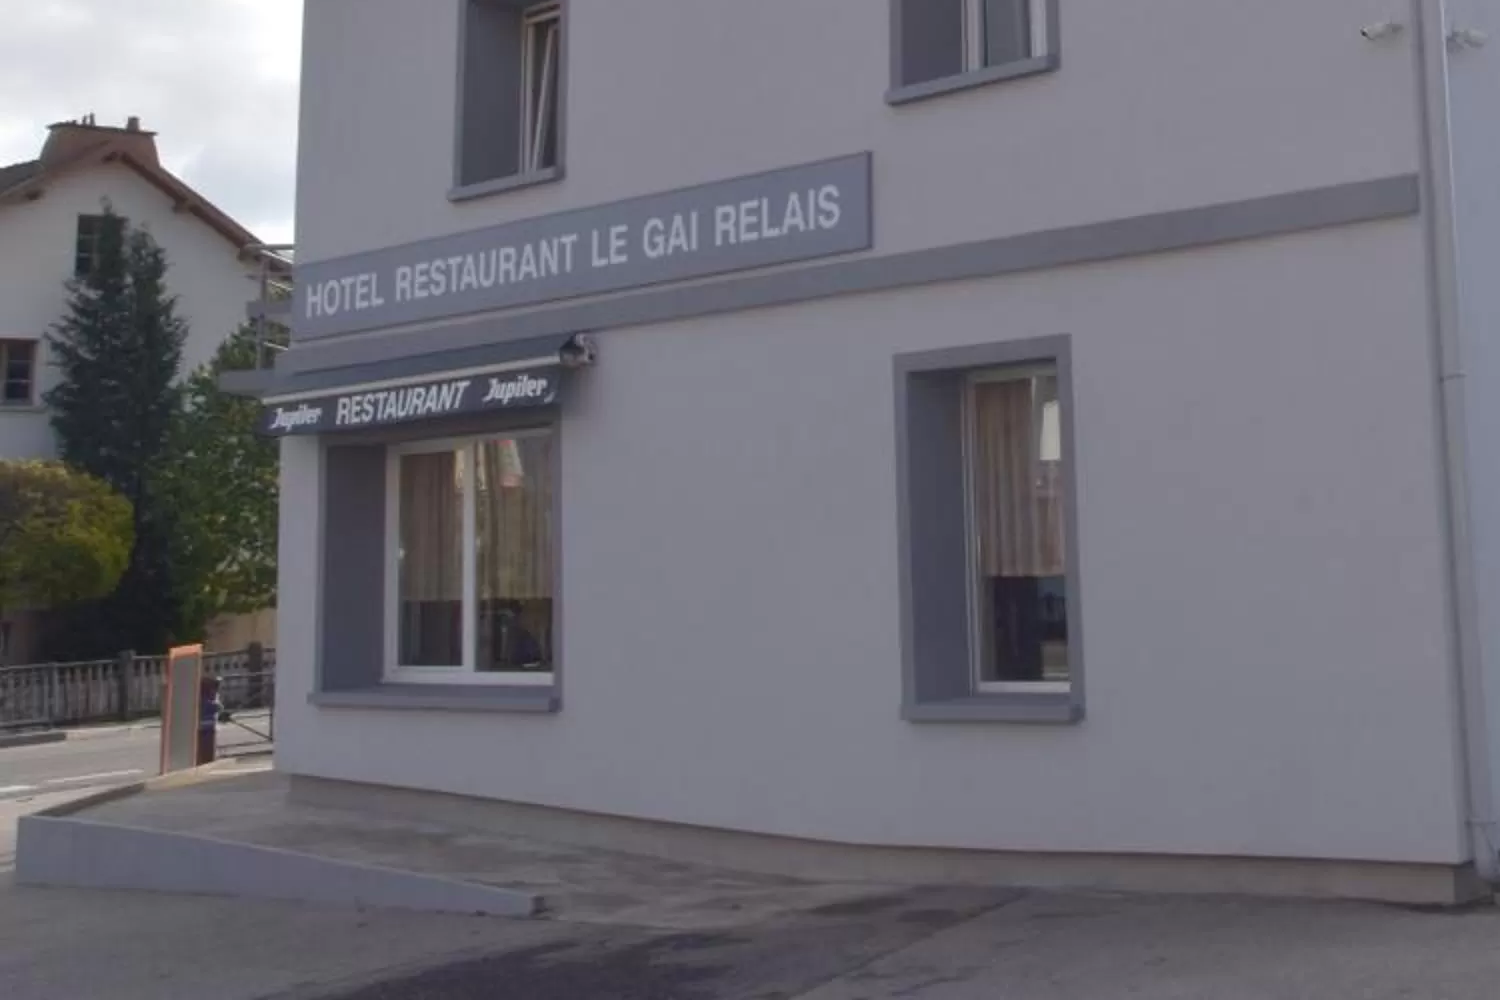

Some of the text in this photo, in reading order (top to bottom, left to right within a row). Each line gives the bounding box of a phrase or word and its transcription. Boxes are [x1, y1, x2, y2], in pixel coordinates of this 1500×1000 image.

[306, 184, 841, 318] HOTEL RESTAURANT LE GAI RELAIS
[336, 381, 470, 425] RESTAURANT
[483, 375, 549, 404] Jupiler
